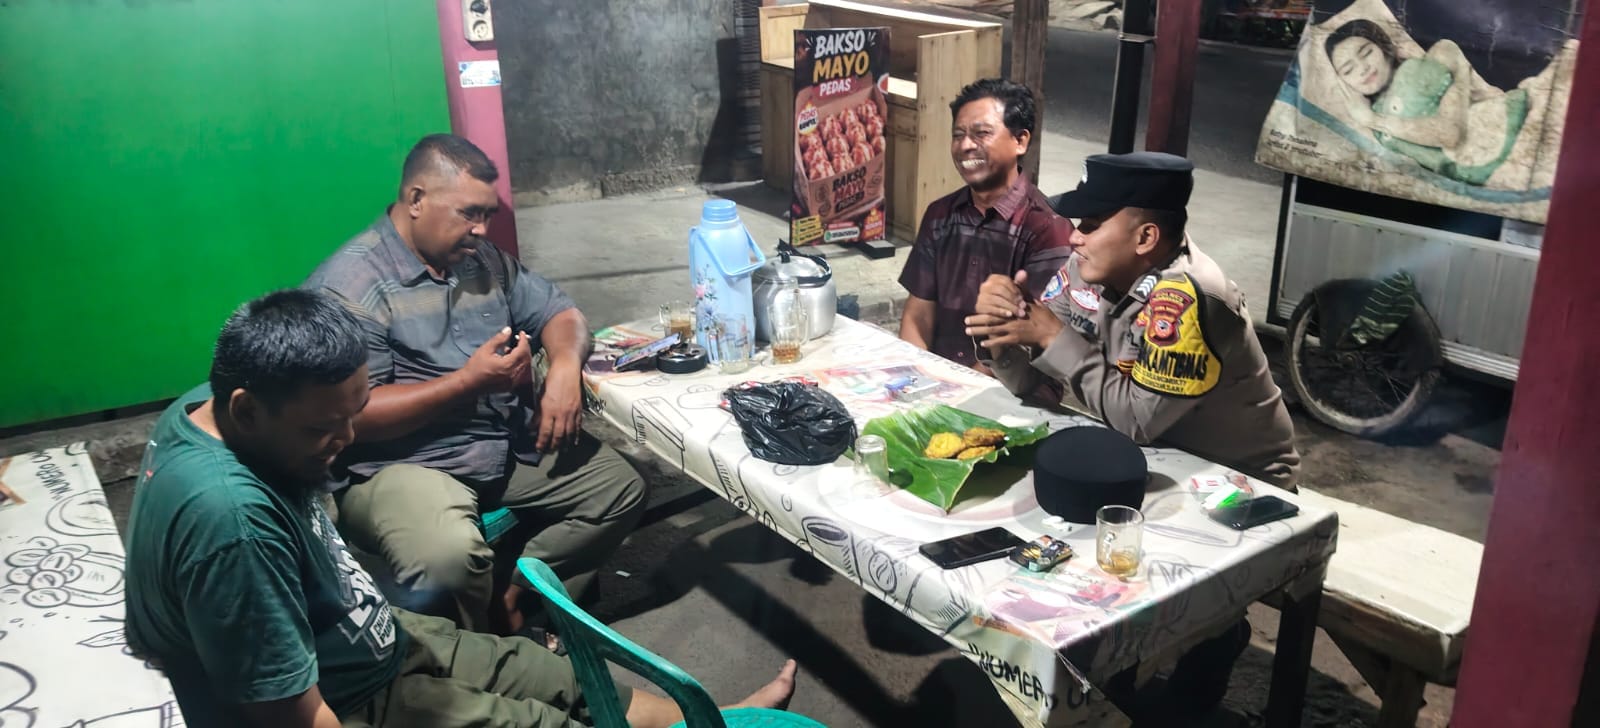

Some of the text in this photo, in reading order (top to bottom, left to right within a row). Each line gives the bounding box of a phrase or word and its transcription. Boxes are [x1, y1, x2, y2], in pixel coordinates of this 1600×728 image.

[814, 29, 866, 59] BAKSO
[813, 50, 870, 83] MAYO
[819, 78, 852, 97] PEDAS
[832, 165, 867, 192] BAKSO
[834, 178, 867, 204] MAYO
